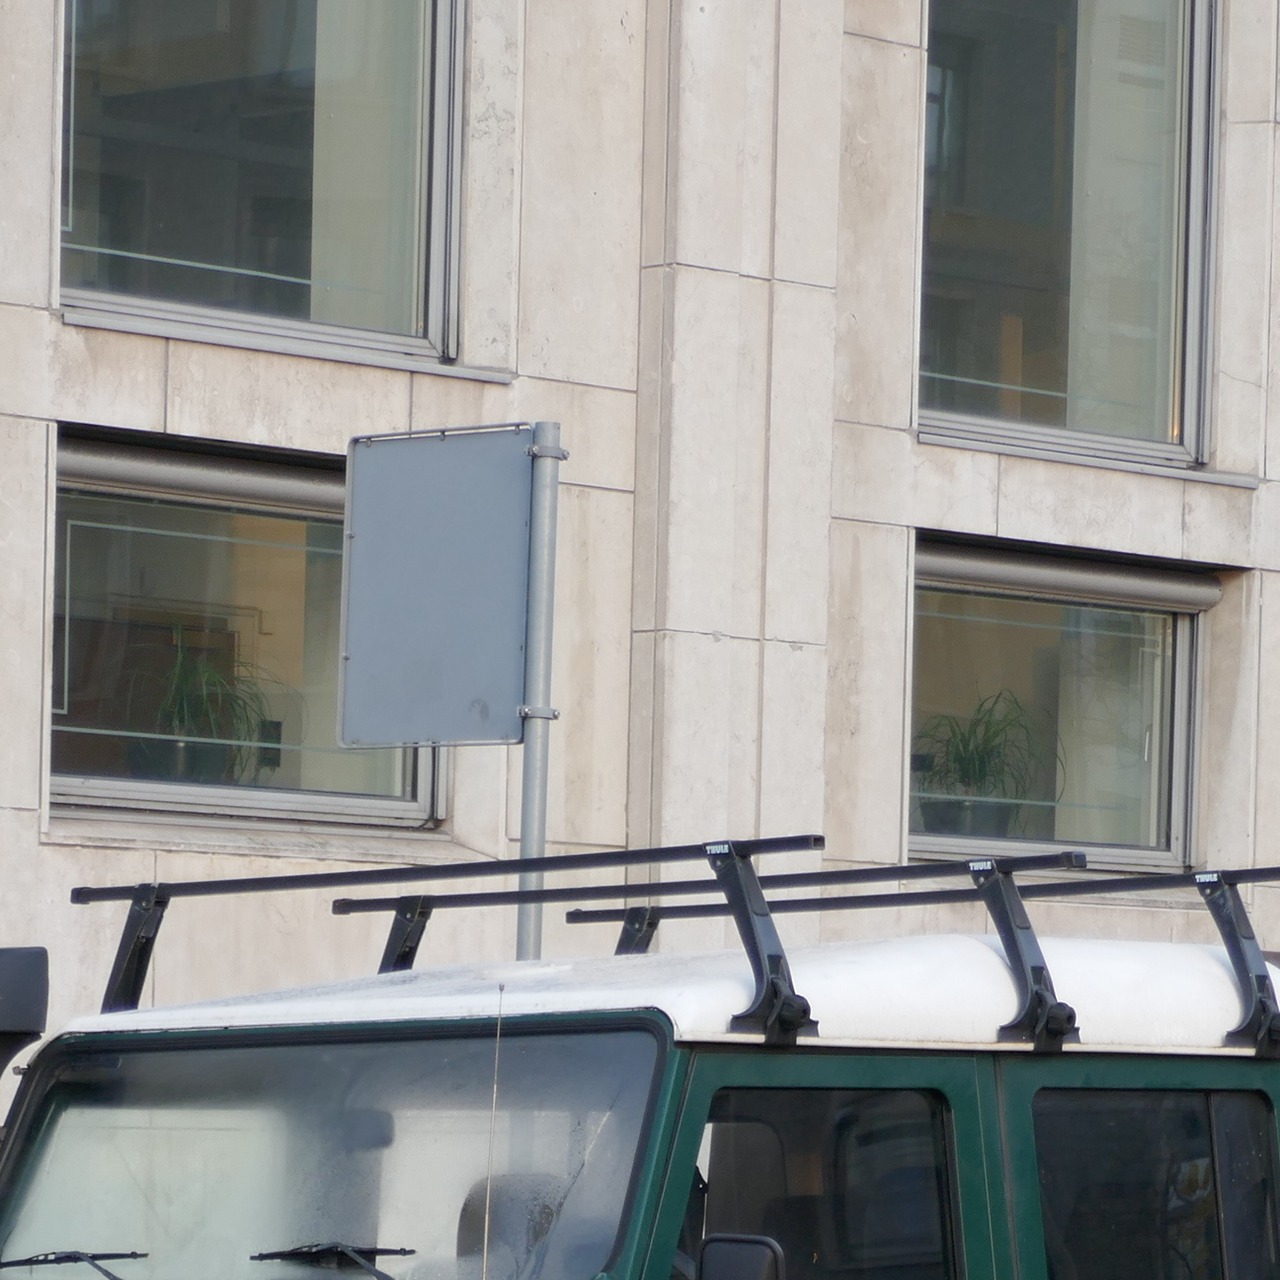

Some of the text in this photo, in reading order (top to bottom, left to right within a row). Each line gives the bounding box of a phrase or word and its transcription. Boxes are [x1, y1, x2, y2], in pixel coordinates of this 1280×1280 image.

[705, 844, 729, 855] THULE
[968, 861, 992, 871] THULE
[1194, 873, 1218, 883] THULE
